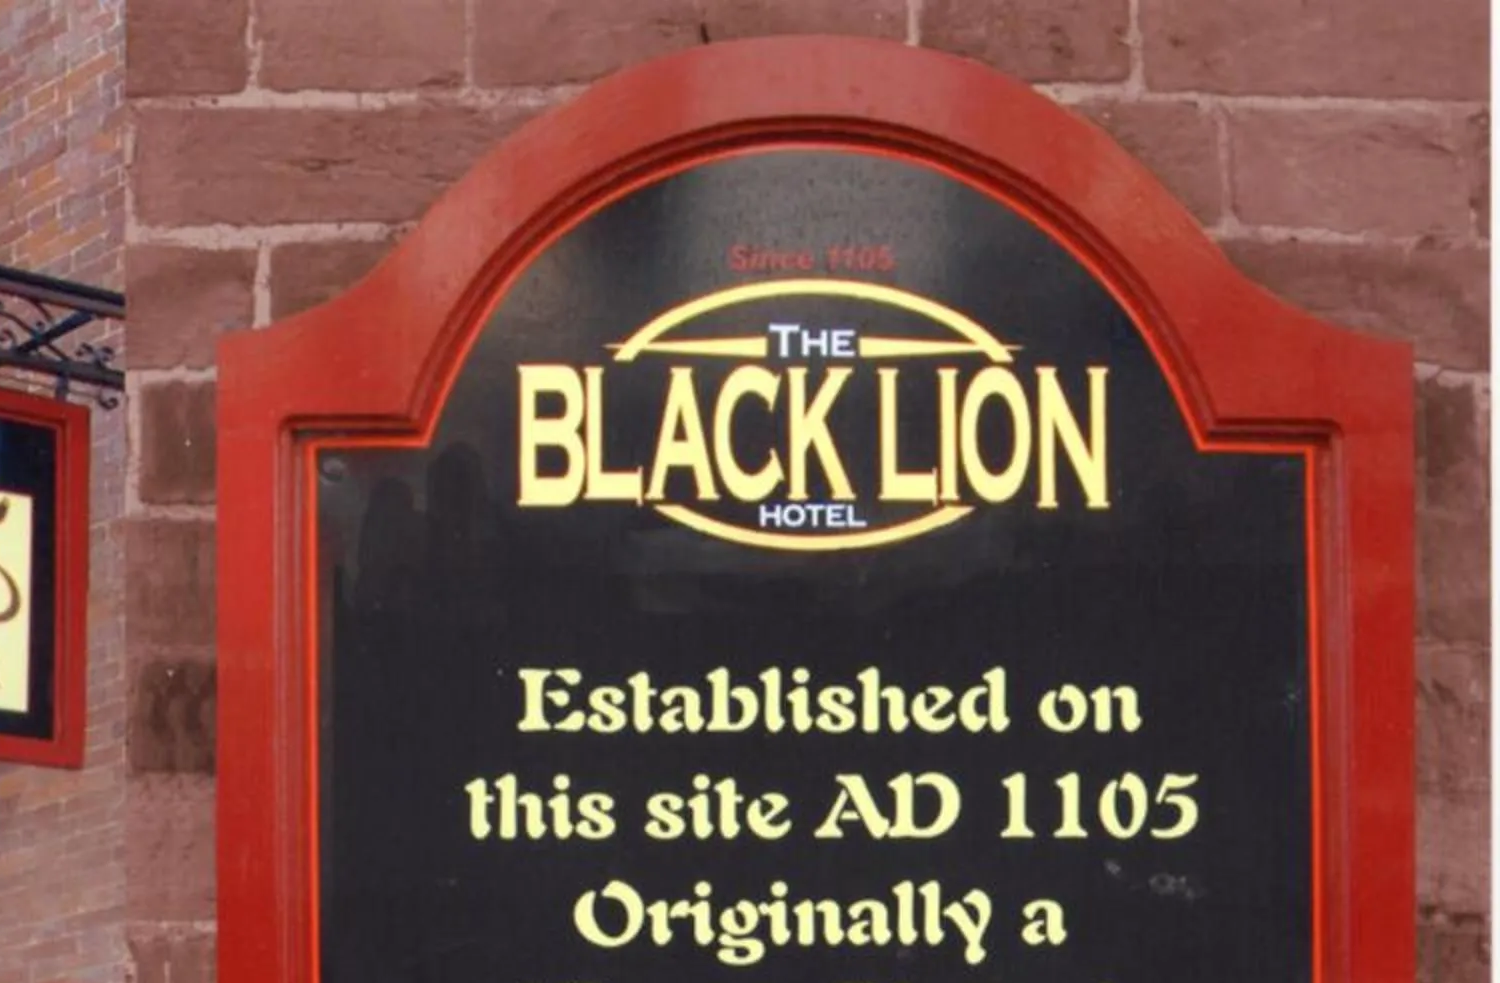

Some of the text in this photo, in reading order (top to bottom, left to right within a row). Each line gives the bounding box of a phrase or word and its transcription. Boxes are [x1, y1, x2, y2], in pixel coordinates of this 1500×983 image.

[728, 243, 896, 271] Since 1105
[769, 324, 856, 359] THE
[518, 364, 1110, 508] BLACK LION
[759, 503, 867, 528] HOTEL
[517, 667, 1143, 734] Established on
[464, 772, 1200, 841] this site AD 1105
[573, 879, 1068, 967] Originally a
